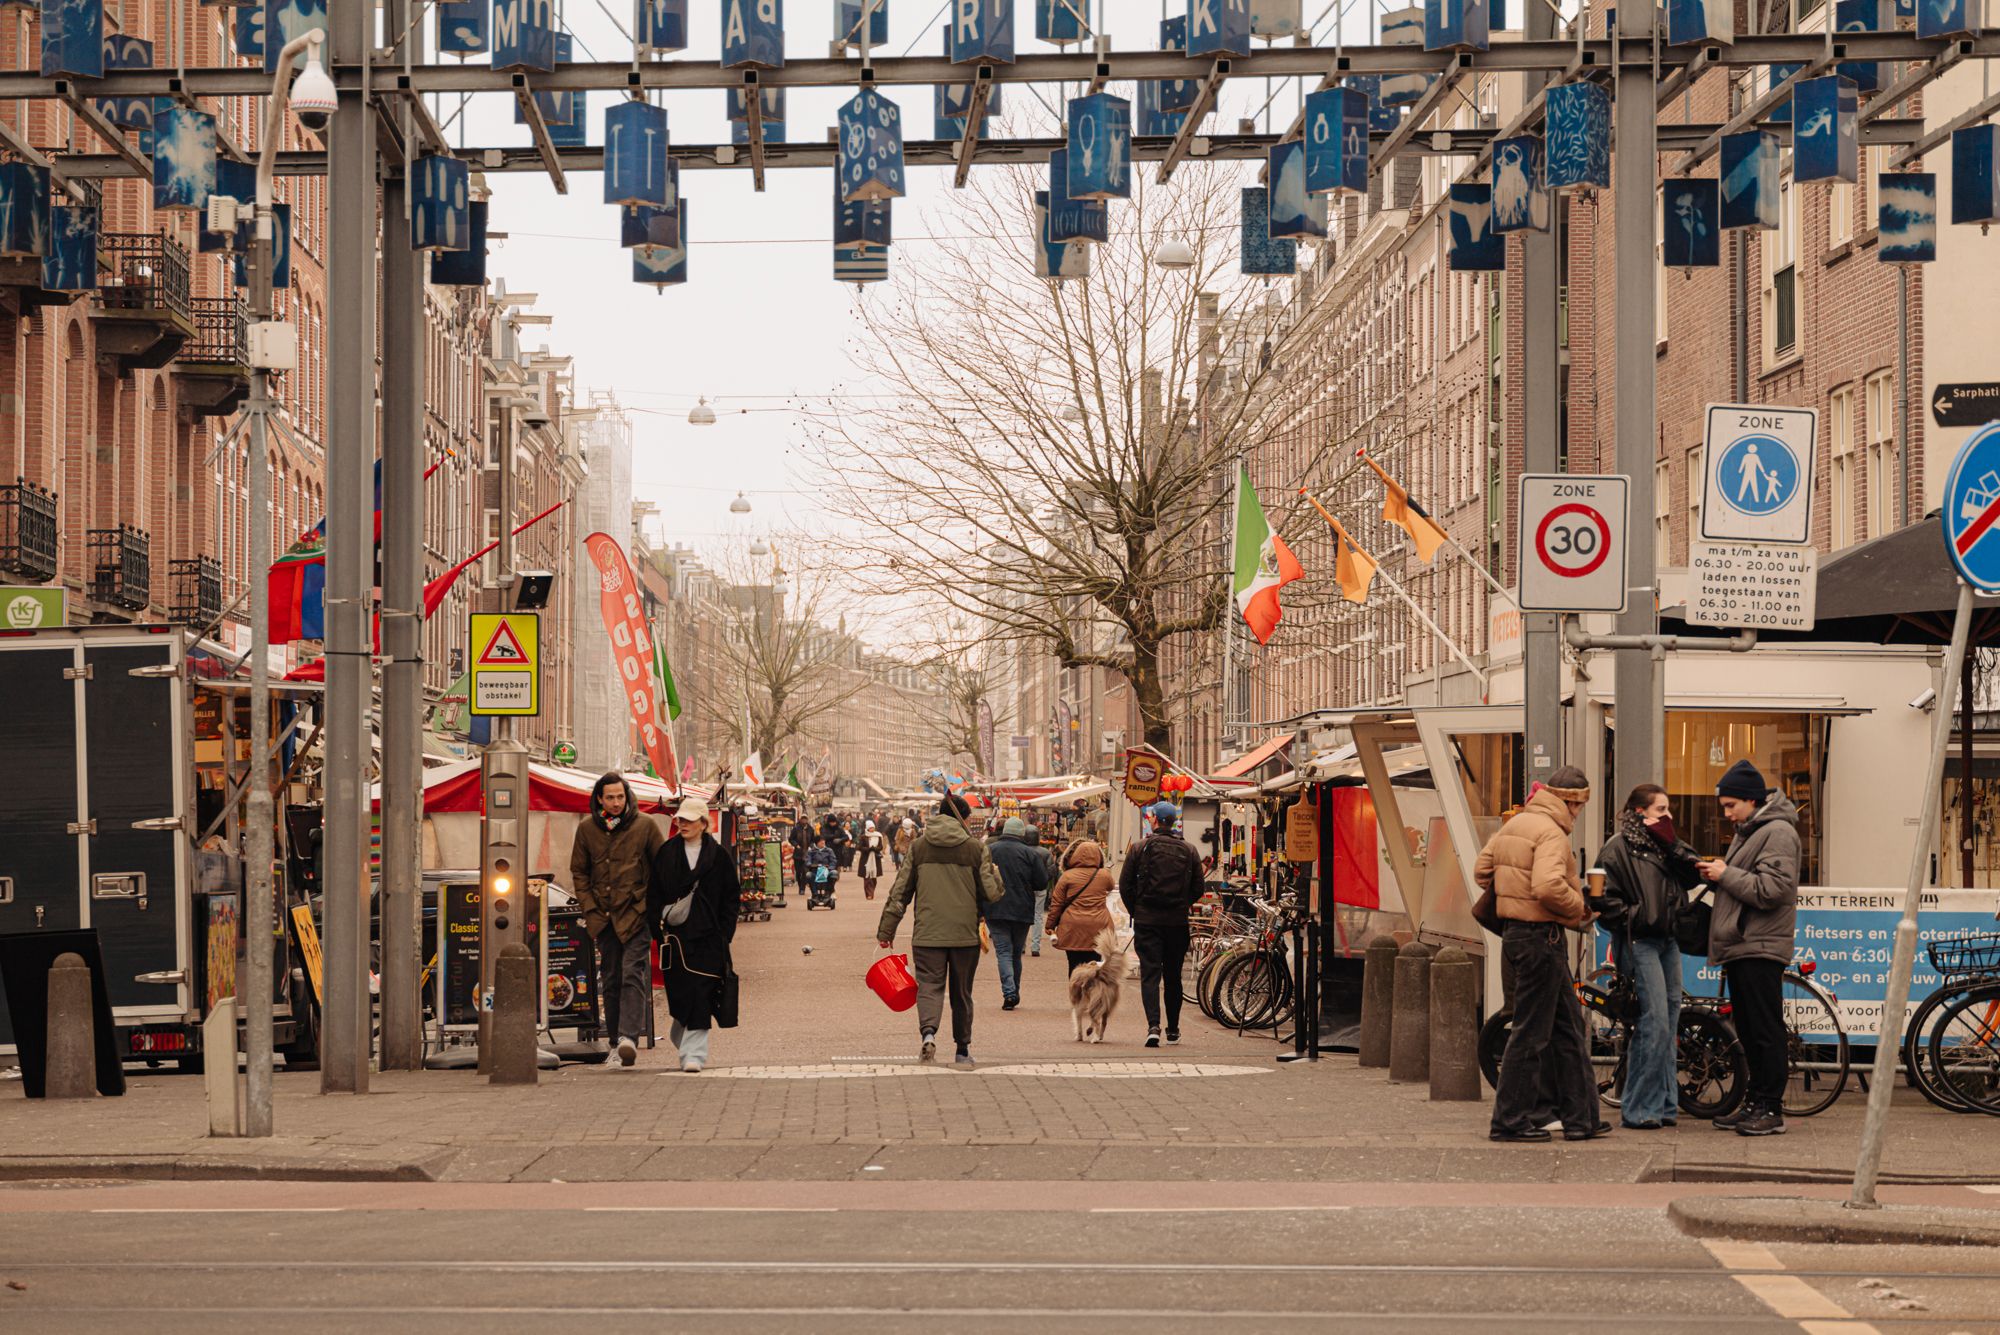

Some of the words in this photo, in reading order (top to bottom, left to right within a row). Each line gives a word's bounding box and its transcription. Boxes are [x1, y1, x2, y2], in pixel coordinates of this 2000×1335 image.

[1739, 415, 1784, 430] ZONE
[1553, 484, 1596, 497] ZONE
[1551, 526, 1596, 555] 30
[1708, 547, 1726, 556] ma
[1731, 547, 1752, 557] t/m
[1757, 549, 1771, 558] za
[1776, 550, 1799, 559] van
[1694, 558, 1732, 568] 06.30
[1746, 561, 1784, 571] 20.00
[1789, 564, 1811, 573] uur
[1702, 572, 1737, 582] laden
[1761, 575, 1801, 586] lossen
[1702, 586, 1772, 597] toegestaan
[1777, 591, 1800, 599] van
[1699, 598, 1737, 609] 06.30
[1751, 601, 1781, 611] 11.00
[1786, 604, 1801, 612] en
[1695, 611, 1729, 621] 16.30
[1743, 613, 1777, 624] 21.00
[1782, 618, 1804, 626] uur
[479, 681, 529, 690] beweegbaar
[1128, 784, 1156, 793] ramen
[1830, 895, 1895, 908] TERREIN
[450, 922, 480, 933] Classic
[1804, 924, 1863, 939] fietsers
[1868, 929, 1887, 940] en
[1820, 951, 1847, 961] van
[1820, 972, 1847, 987] op-
[1852, 972, 1871, 983] en
[1796, 1006, 1818, 1015] om
